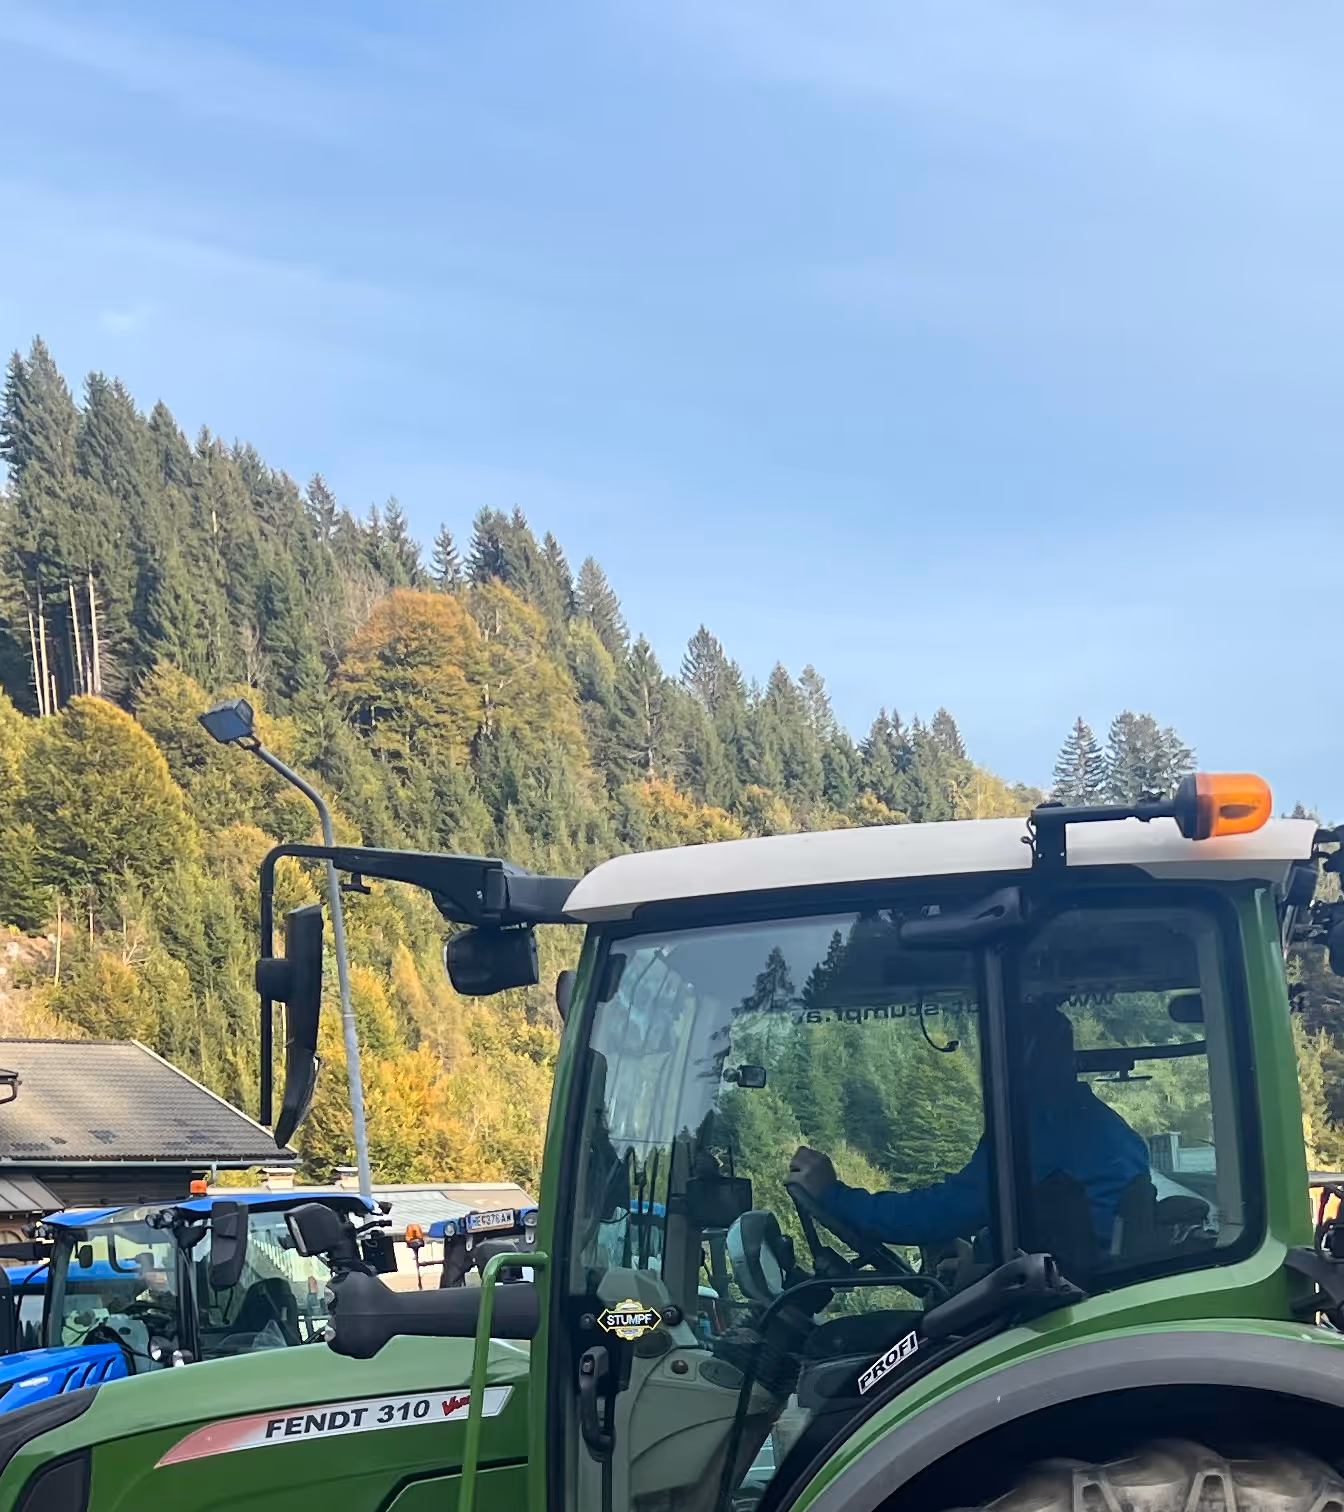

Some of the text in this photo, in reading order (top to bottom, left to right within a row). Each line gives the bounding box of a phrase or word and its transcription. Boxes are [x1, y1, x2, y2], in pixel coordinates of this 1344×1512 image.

[606, 1313, 652, 1326] STUMPF
[859, 1333, 916, 1390] PROFI
[265, 1406, 369, 1439] FENDT
[376, 1399, 431, 1424] 310
